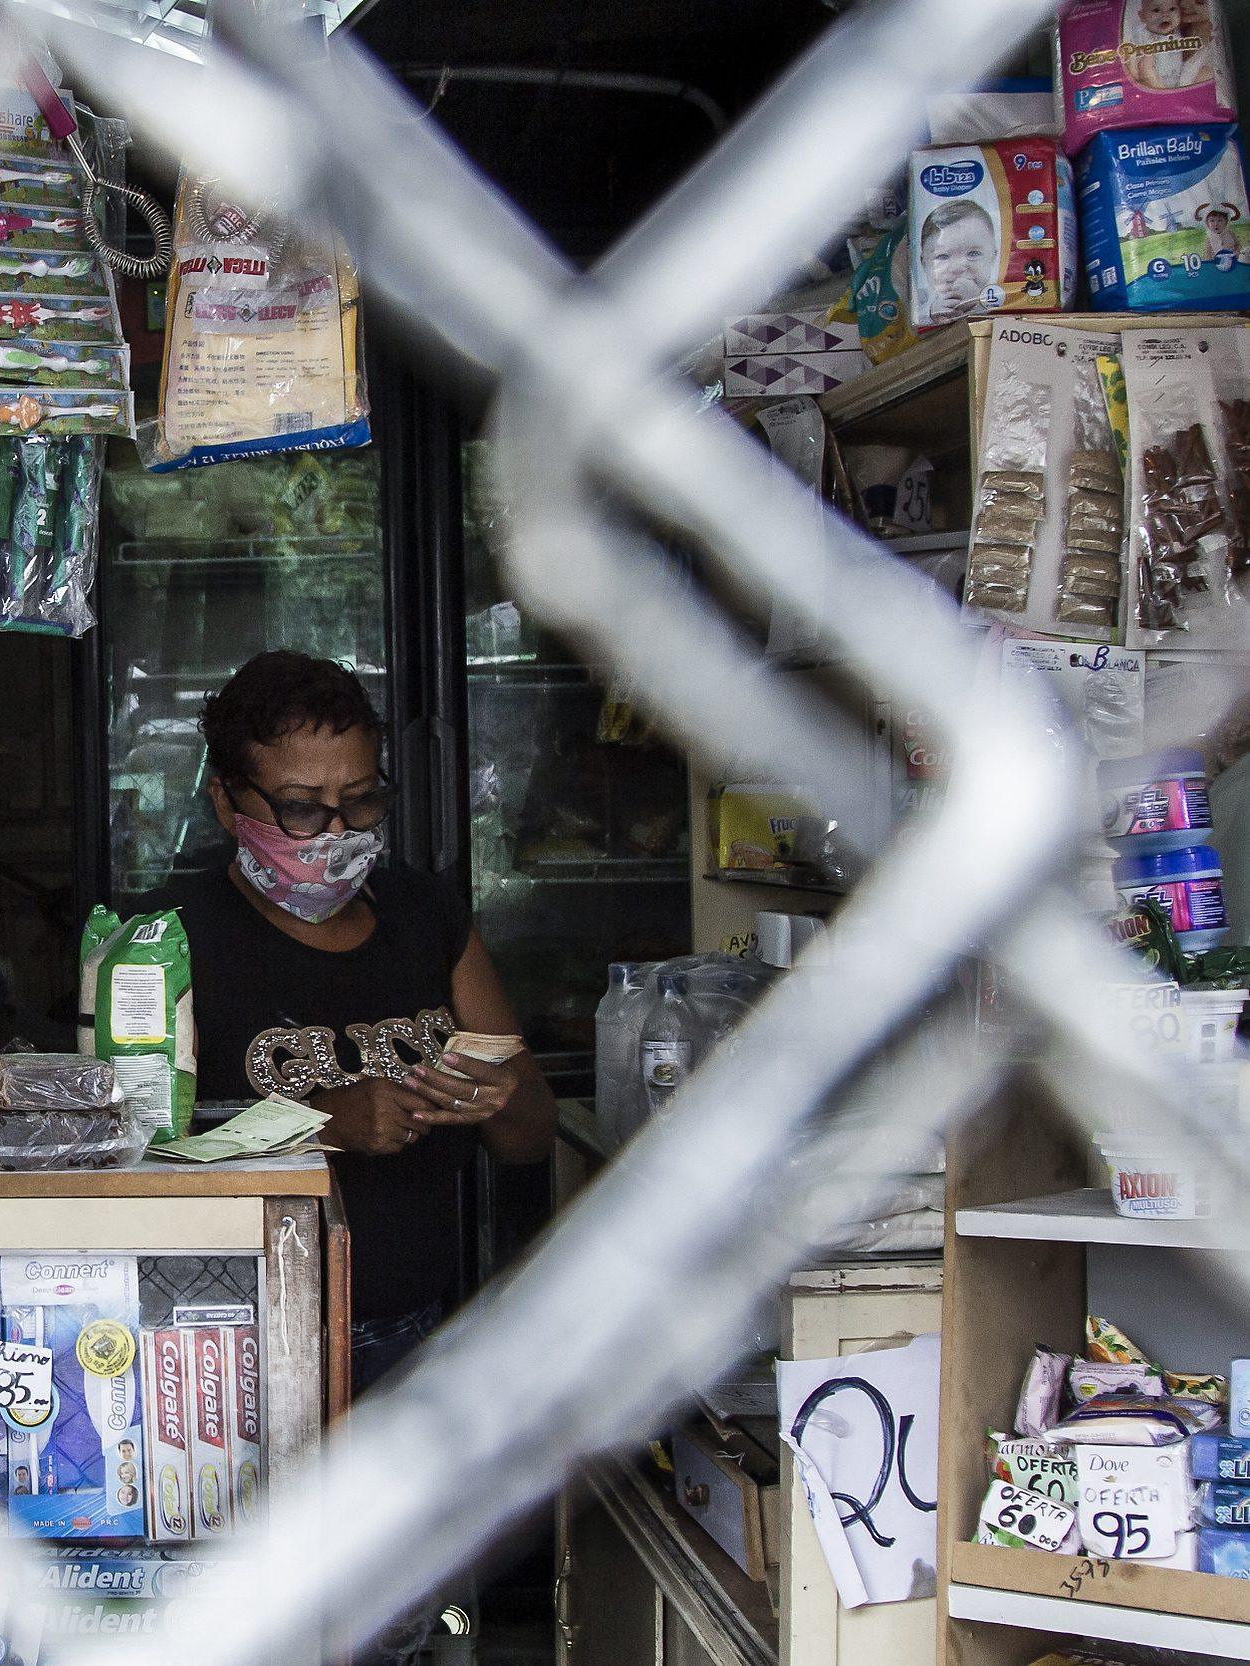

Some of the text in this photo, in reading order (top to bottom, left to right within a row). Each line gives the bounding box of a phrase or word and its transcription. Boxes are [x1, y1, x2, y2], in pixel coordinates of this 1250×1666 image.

[1118, 136, 1203, 161] Brillan Baby
[1014, 153, 1027, 171] 9
[1181, 253, 1201, 272] 10
[1118, 1172, 1180, 1201] AXION
[25, 1260, 109, 1280] Connert
[160, 1341, 180, 1439] Colgate
[201, 1339, 221, 1438] Colgate
[240, 1337, 258, 1436] Colgate
[1017, 1456, 1078, 1477] OFERTA
[1088, 1453, 1131, 1473] Dove
[1000, 1486, 1068, 1522] OFERTA
[1084, 1485, 1160, 1511] OFERTA
[1092, 1511, 1151, 1560] 95
[38, 1564, 146, 1590] Alident
[52, 1606, 158, 1633] lident
